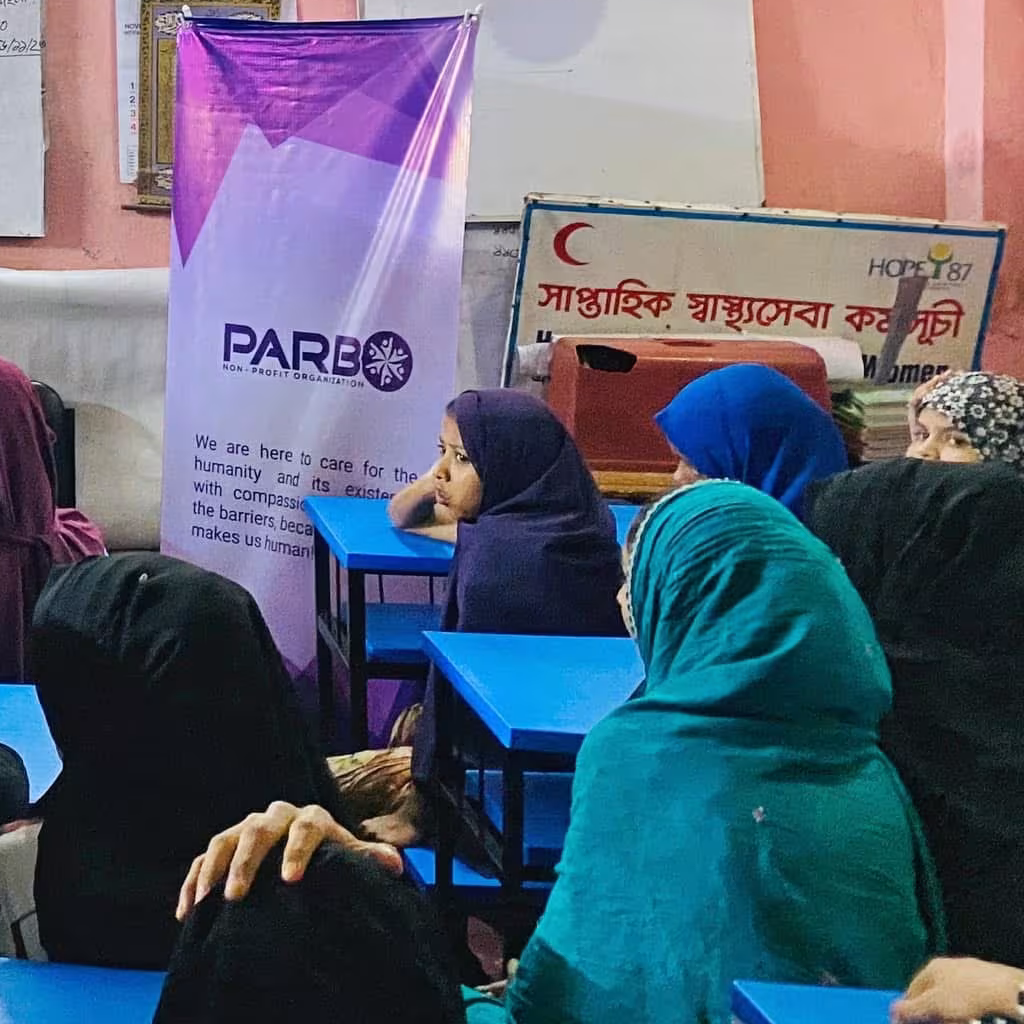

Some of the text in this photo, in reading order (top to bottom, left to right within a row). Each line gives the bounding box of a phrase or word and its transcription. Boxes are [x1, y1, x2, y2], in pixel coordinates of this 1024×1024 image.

[868, 257, 974, 281] HOPE 87
[538, 278, 675, 319] সাপ্তাহিক
[686, 292, 835, 332] স্বাস্থ্যসেবা
[293, 372, 365, 389] ORGANIZATION
[196, 433, 418, 484] We are here to care for the
[193, 480, 222, 497] with
[194, 456, 262, 483] humanity
[277, 470, 300, 487] and
[312, 475, 330, 492] its
[193, 501, 313, 536] the barriers, beca
[191, 525, 240, 545] makes
[245, 533, 262, 548] us
